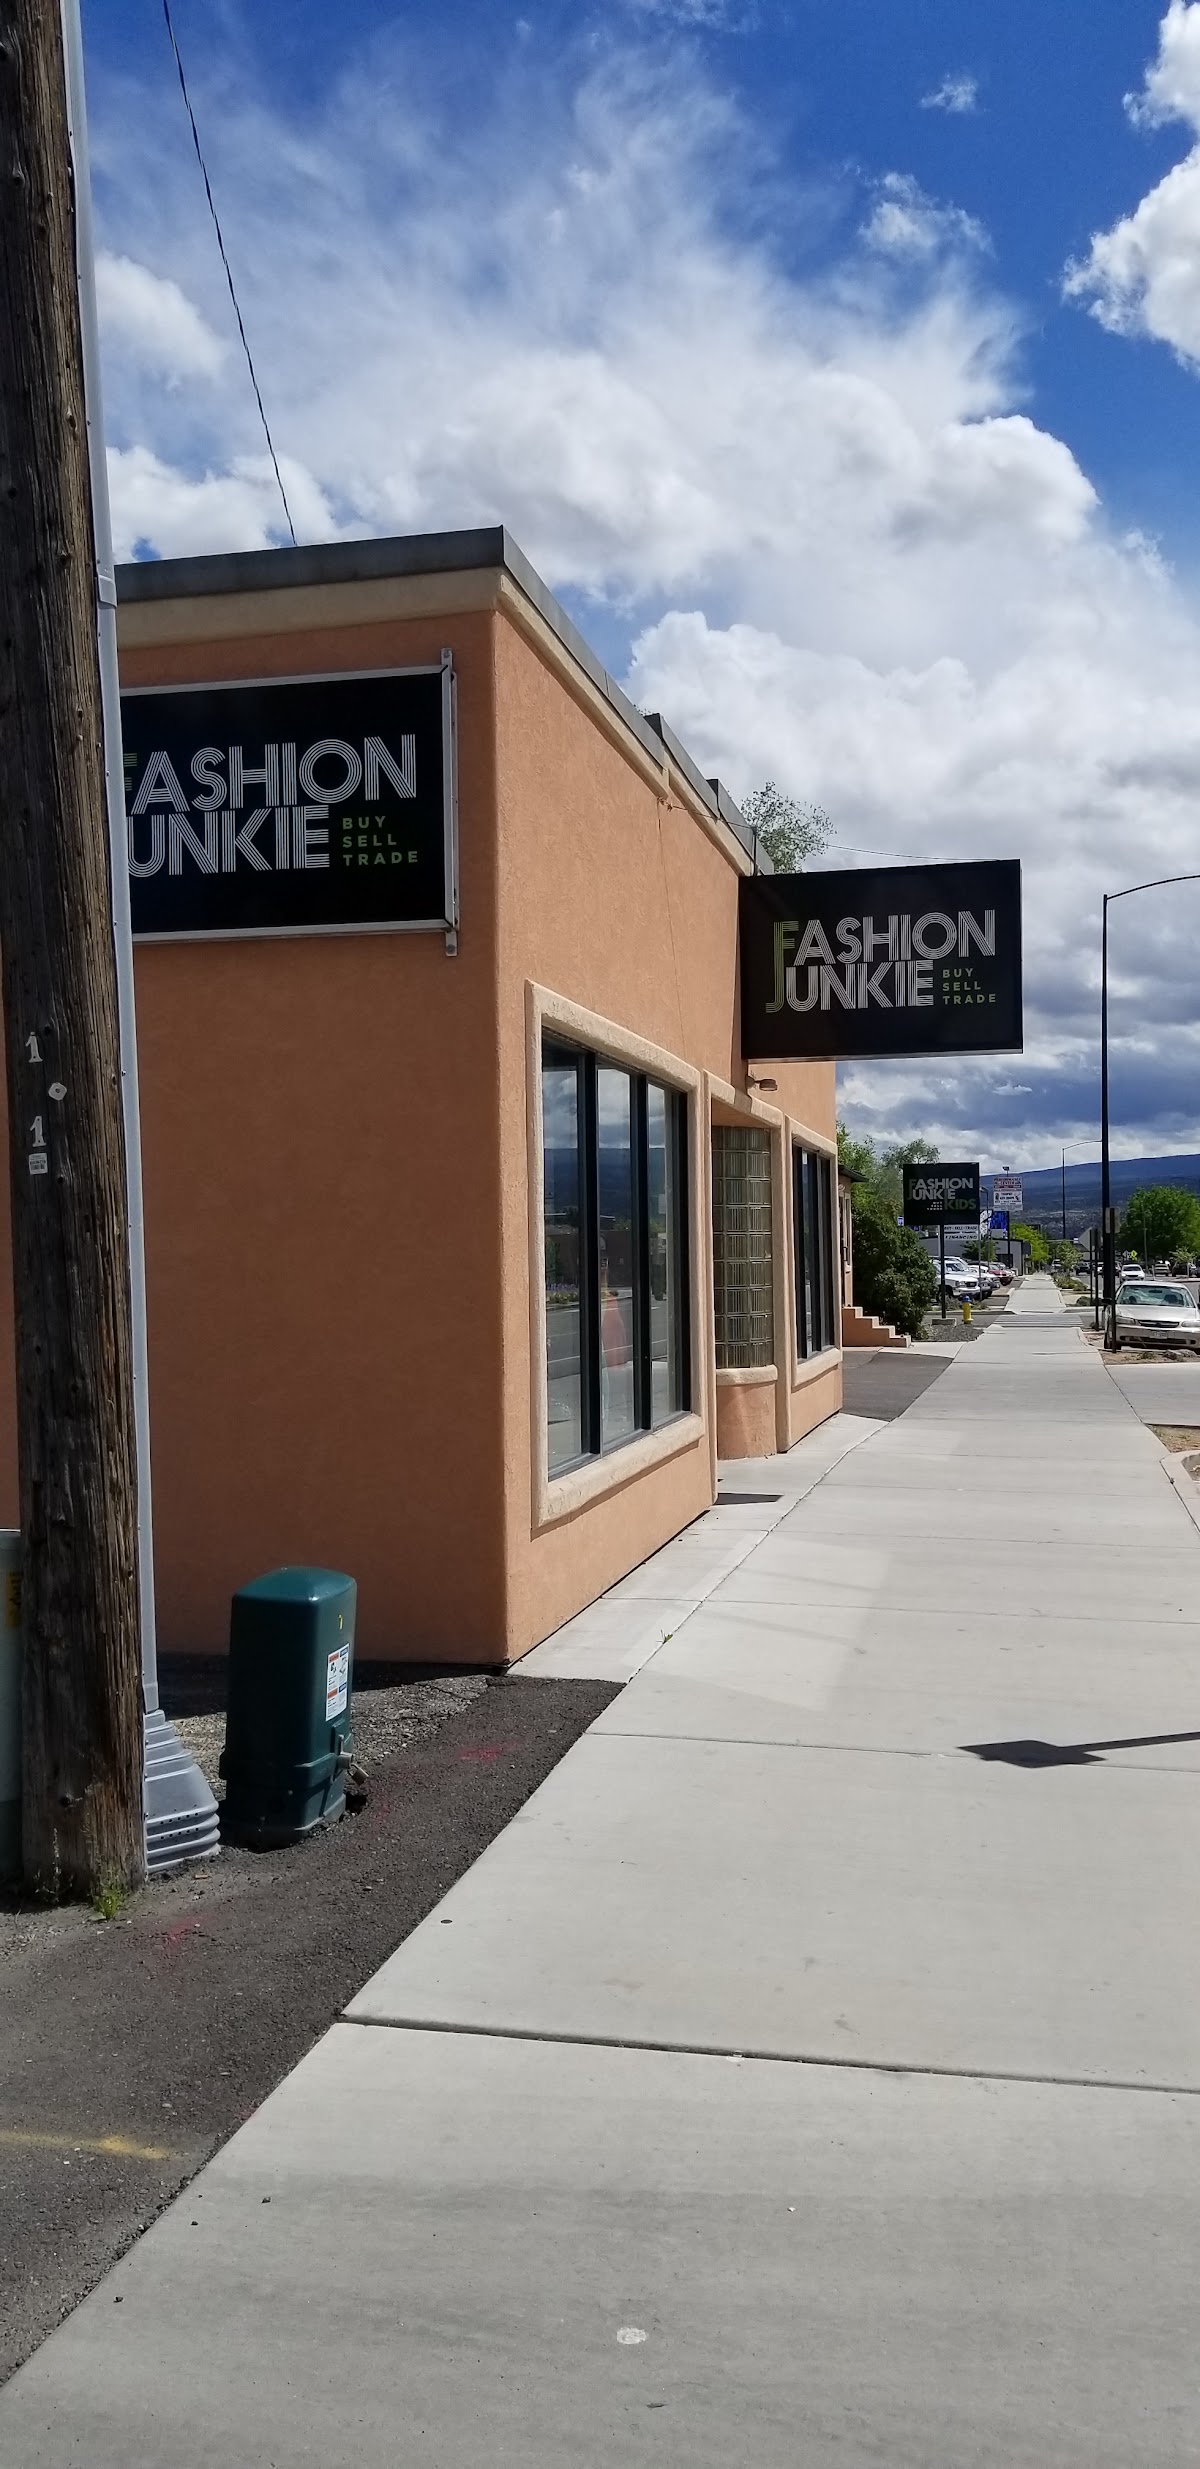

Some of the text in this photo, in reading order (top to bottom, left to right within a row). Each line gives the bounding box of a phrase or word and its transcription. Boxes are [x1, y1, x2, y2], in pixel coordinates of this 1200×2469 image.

[342, 815, 386, 830] BUY
[126, 804, 331, 878] UNKIE
[342, 833, 398, 849] SELL
[342, 850, 418, 867] TRADE
[773, 909, 996, 967] FASHION
[942, 967, 975, 978] BUY
[765, 959, 935, 1014] JUNKIE
[942, 980, 982, 992] SELL
[942, 993, 997, 1005] TRADE
[25, 1031, 43, 1063] 1
[29, 1115, 47, 1148] 1
[908, 1177, 974, 1190] FASHION
[944, 1198, 977, 1211] KIDS
